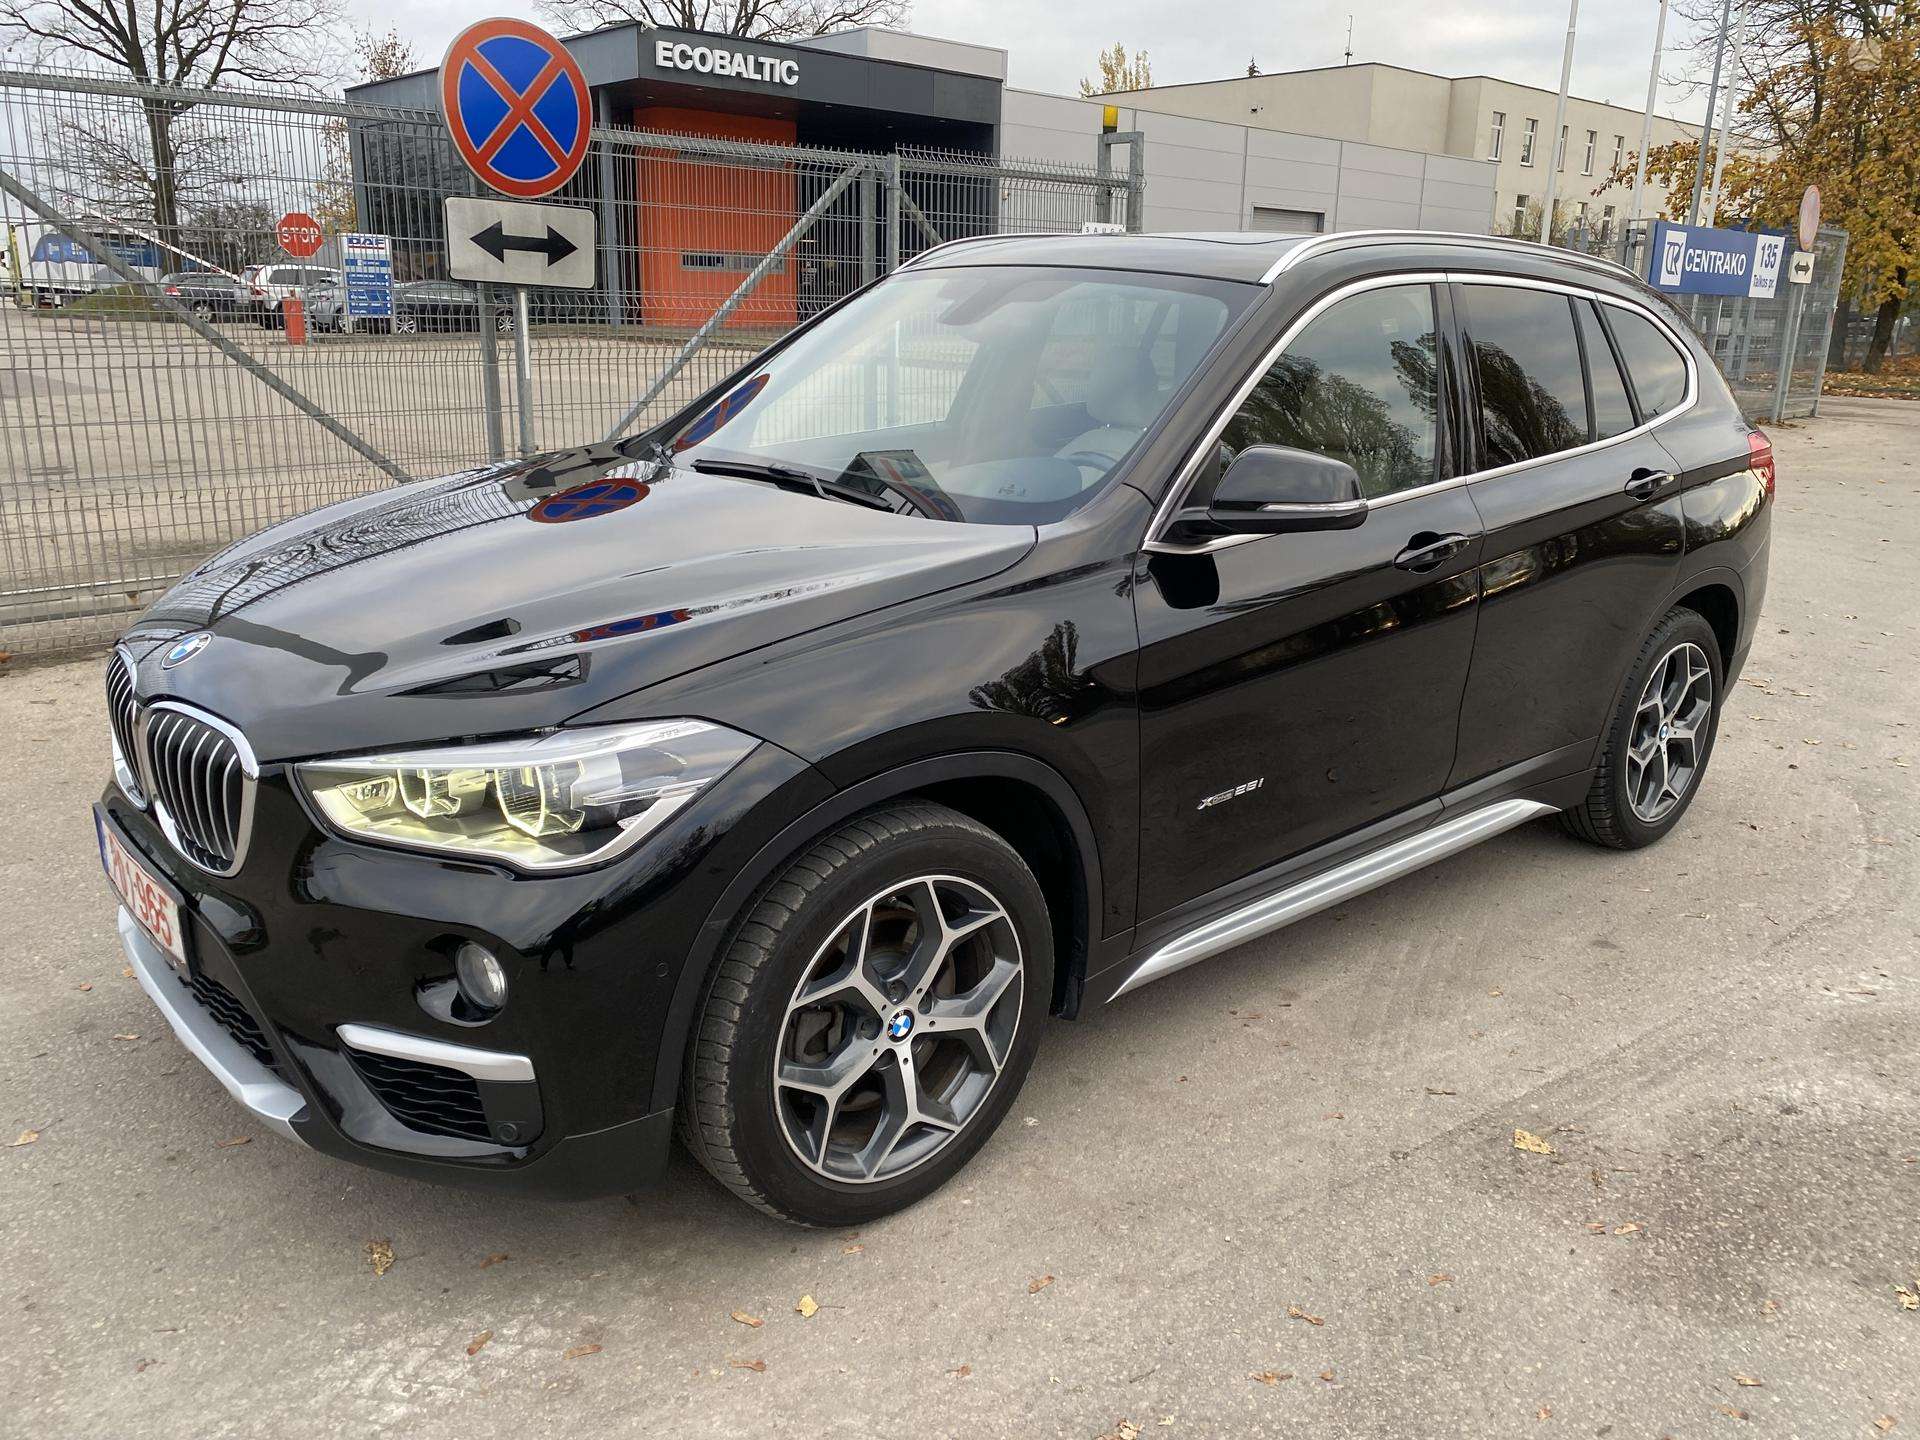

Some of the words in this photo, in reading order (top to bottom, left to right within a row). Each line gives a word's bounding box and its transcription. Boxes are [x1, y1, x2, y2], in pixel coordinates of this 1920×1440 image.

[655, 40, 800, 86] ECOBALTIC
[281, 226, 319, 243] STOP
[1684, 248, 1746, 276] CENTRAKO
[1760, 242, 1779, 269] 135
